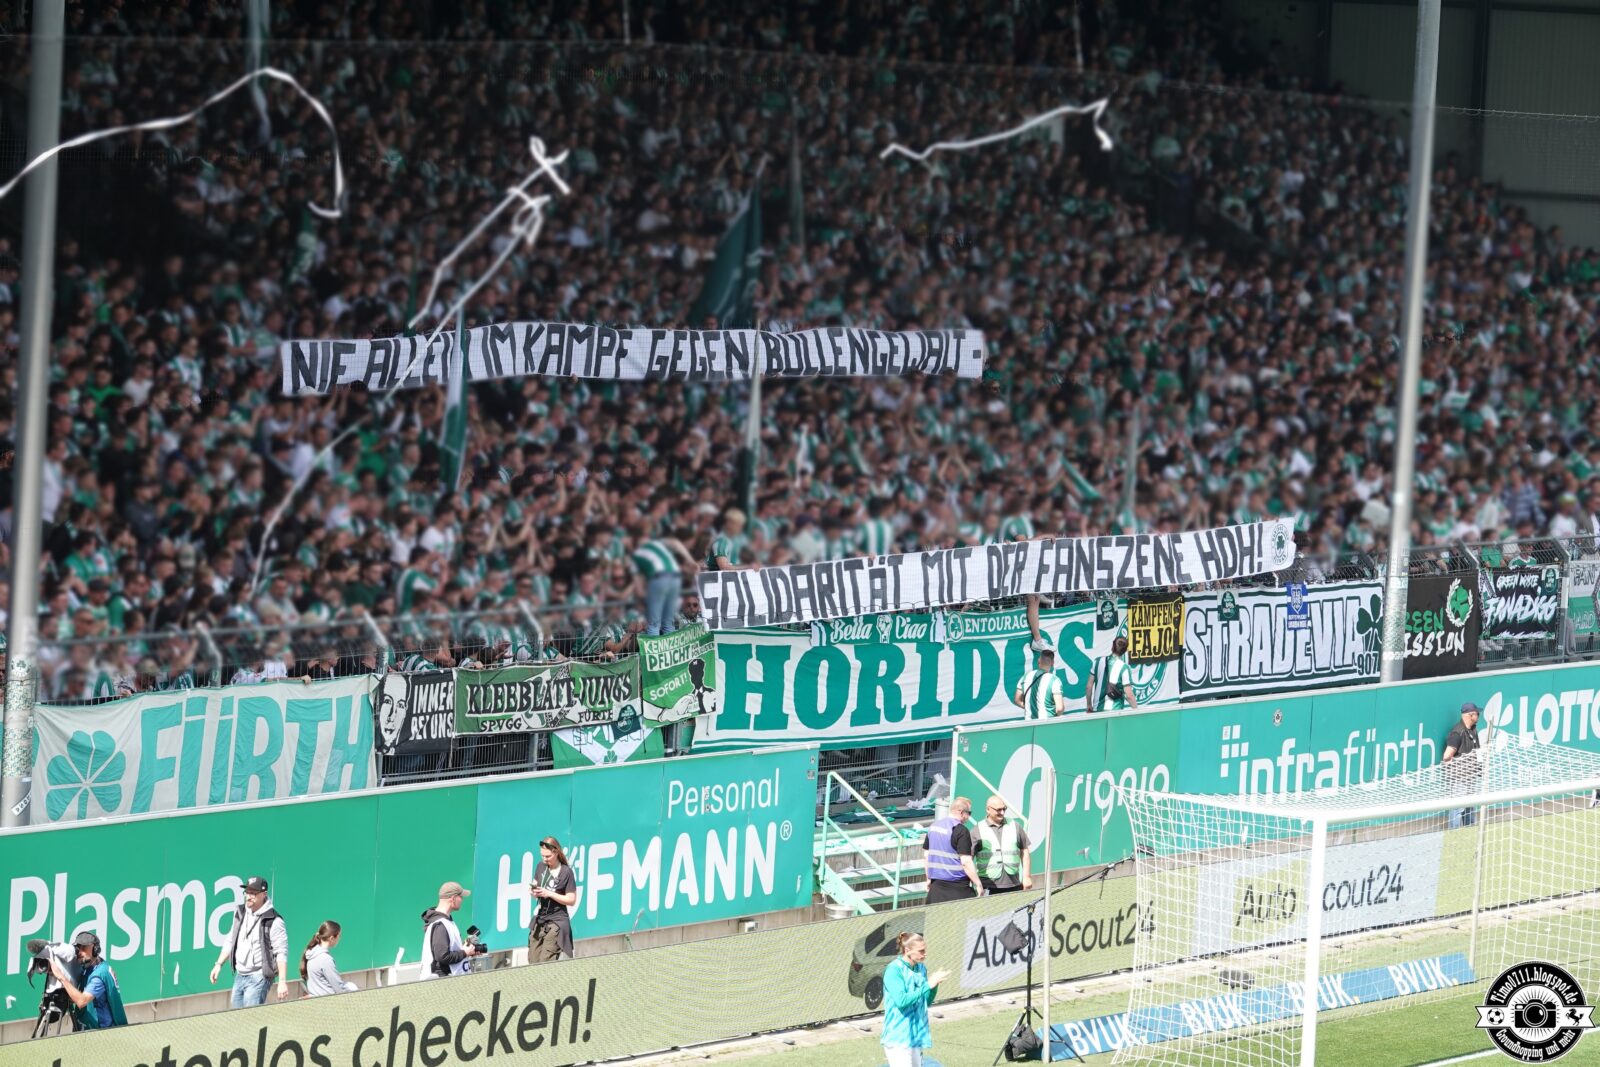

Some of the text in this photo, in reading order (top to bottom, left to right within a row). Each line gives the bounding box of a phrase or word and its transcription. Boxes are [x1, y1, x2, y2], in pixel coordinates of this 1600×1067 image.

[291, 341, 356, 393] NIE
[482, 323, 516, 378] IM
[523, 323, 633, 378] KAMPF
[645, 330, 750, 380] GEGEN
[761, 327, 966, 376] BULLENGEWALT
[699, 555, 903, 630] SOLIDARITÄT
[921, 547, 972, 605] MIT
[987, 542, 1029, 598] DER
[1034, 534, 1192, 592] FANSZENE
[1194, 523, 1263, 580] HDH!
[895, 616, 926, 640] Ciao
[964, 613, 1028, 634] ENTOURAG
[1131, 601, 1173, 627] KÄMPFEN
[649, 646, 690, 671] PFLICHT
[1404, 628, 1465, 659] ISSION
[1357, 653, 1378, 675] 907
[413, 681, 454, 714] IMMER
[649, 672, 688, 701] SOFORT!
[430, 712, 454, 739] UNS
[480, 718, 522, 732] SPVGG
[130, 694, 374, 814] FÜRTH
[668, 768, 779, 818] Personal
[1322, 863, 1404, 911] cout24
[352, 978, 597, 1067] checken!
